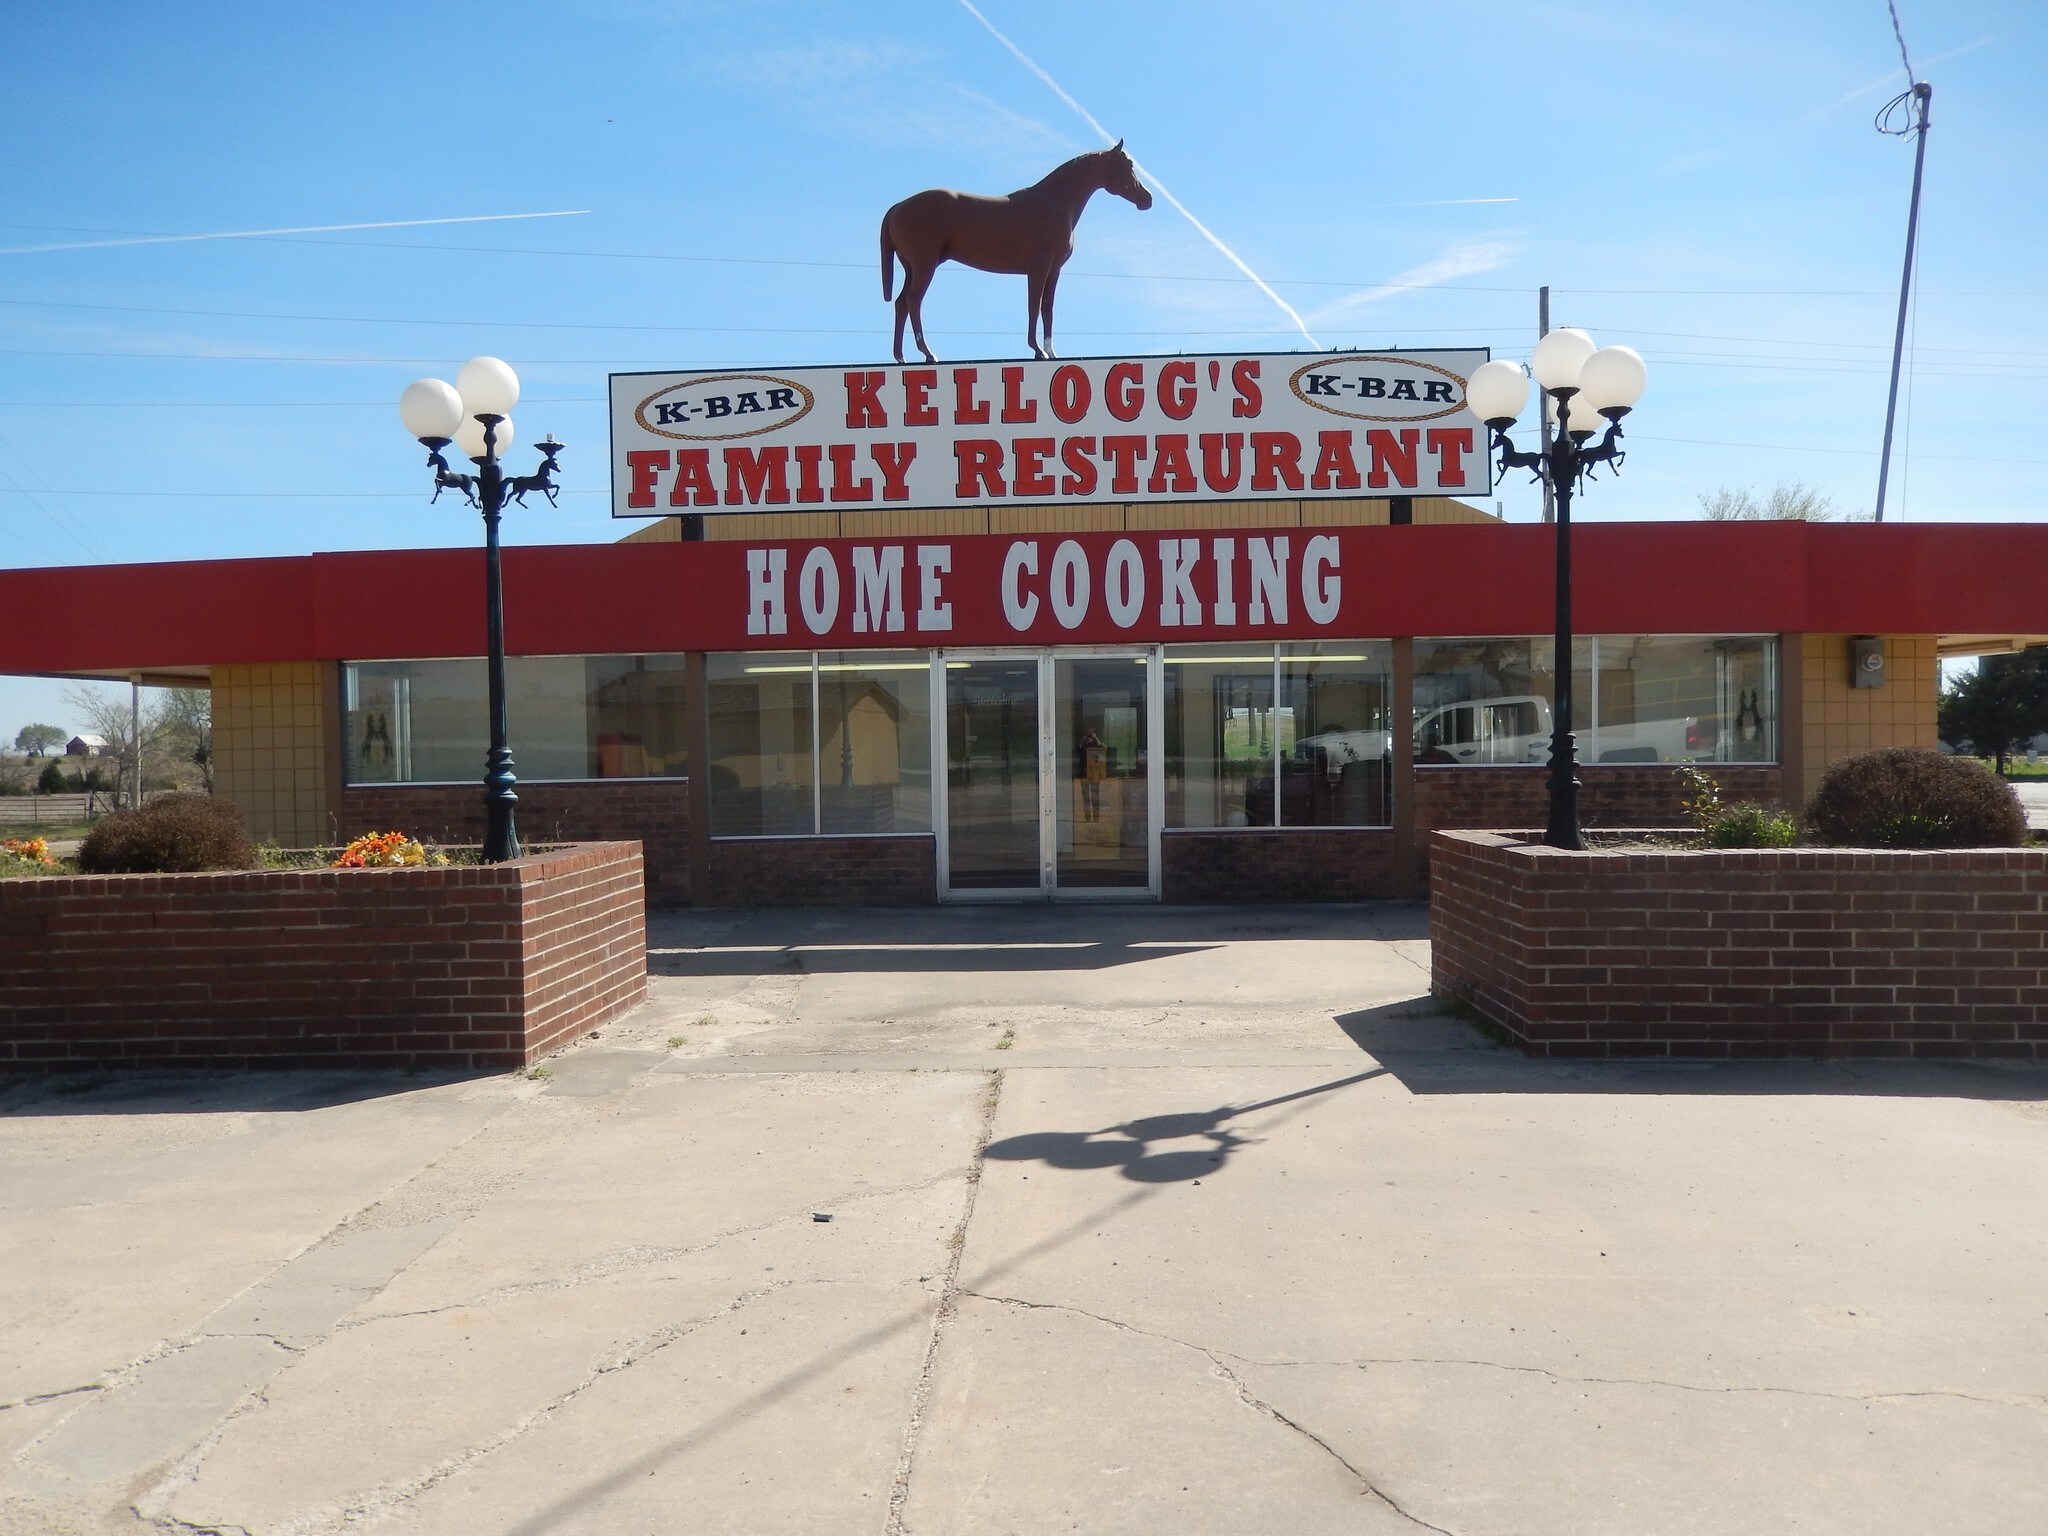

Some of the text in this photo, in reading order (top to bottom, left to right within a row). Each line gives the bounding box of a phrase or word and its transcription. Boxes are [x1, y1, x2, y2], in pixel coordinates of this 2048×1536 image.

[655, 388, 799, 425] K-BAR
[844, 360, 1262, 428] KELLOGG'S
[1305, 374, 1457, 403] K-BAR
[627, 427, 1474, 508] FAMILY RESTAURANT
[746, 534, 1342, 635] HOME COOKING
